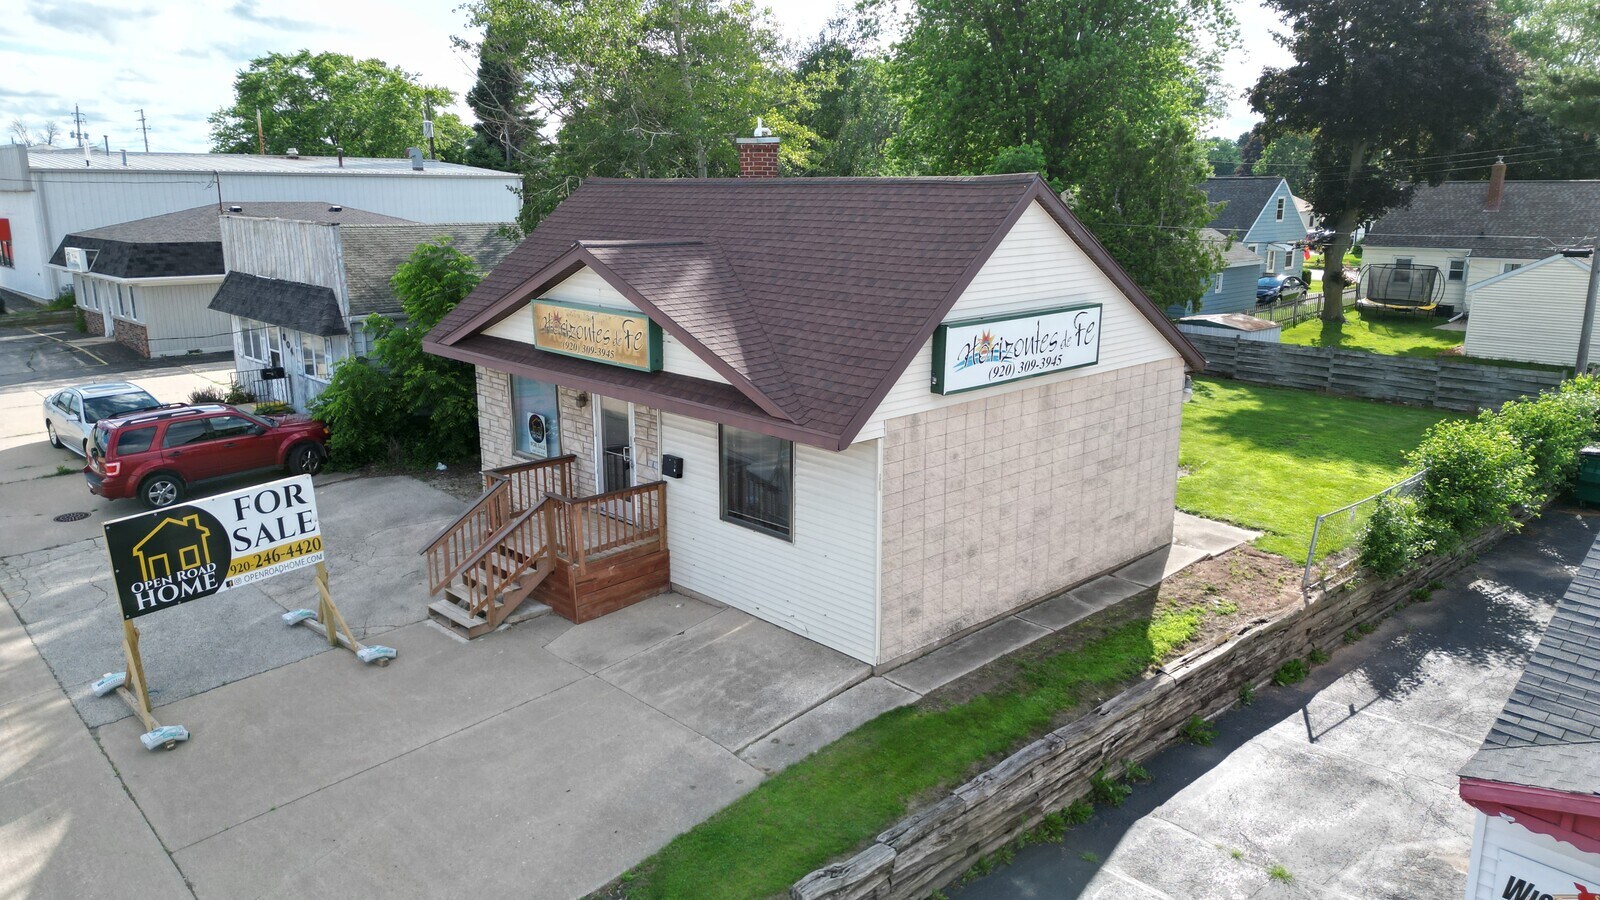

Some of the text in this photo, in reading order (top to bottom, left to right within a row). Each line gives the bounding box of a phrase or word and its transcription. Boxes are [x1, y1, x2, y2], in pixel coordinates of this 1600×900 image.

[621, 319, 643, 351] Fe
[1059, 329, 1072, 350] de
[1073, 311, 1095, 347] Fe
[562, 341, 615, 359] (920) 309-3945
[988, 354, 1063, 381] (920) 309-3945
[233, 483, 308, 521] FOR
[232, 509, 316, 552] SALE
[230, 537, 322, 576] 920-246-4420
[244, 553, 323, 583] OPENROADHOME.COM
[131, 562, 217, 594] OPEN ROAD
[135, 571, 219, 611] HOME
